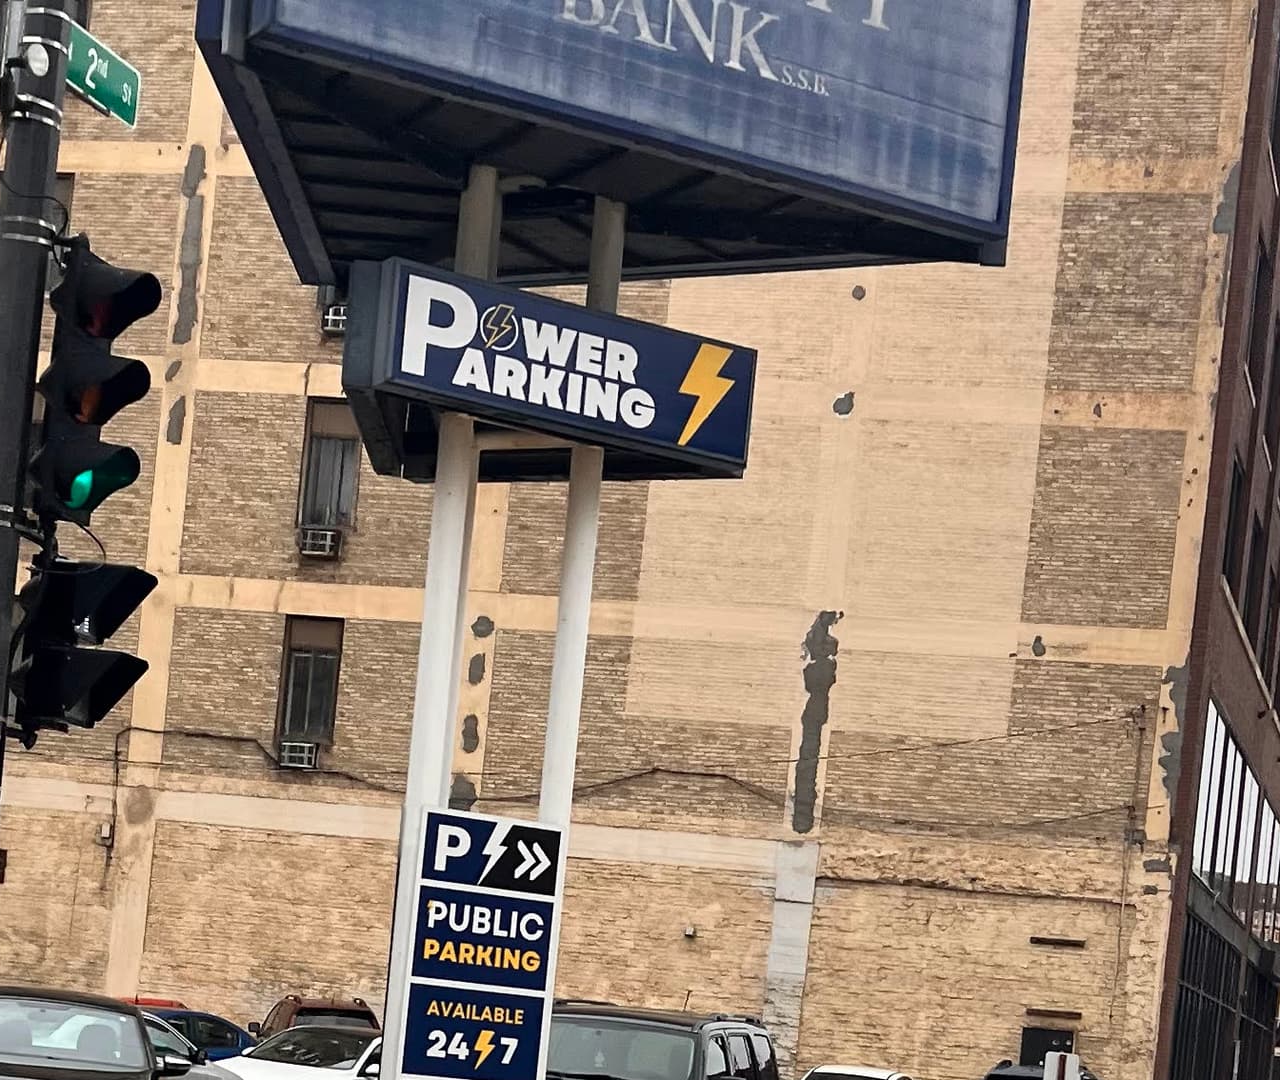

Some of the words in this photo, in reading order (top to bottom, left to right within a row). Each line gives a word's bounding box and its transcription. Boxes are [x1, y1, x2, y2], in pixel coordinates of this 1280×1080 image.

[85, 47, 110, 90] 2nd
[121, 82, 132, 106] St
[433, 823, 471, 872] P
[427, 900, 544, 941] PUBLIC
[423, 938, 541, 972] PARKING
[426, 1000, 524, 1025] AVAILABLE
